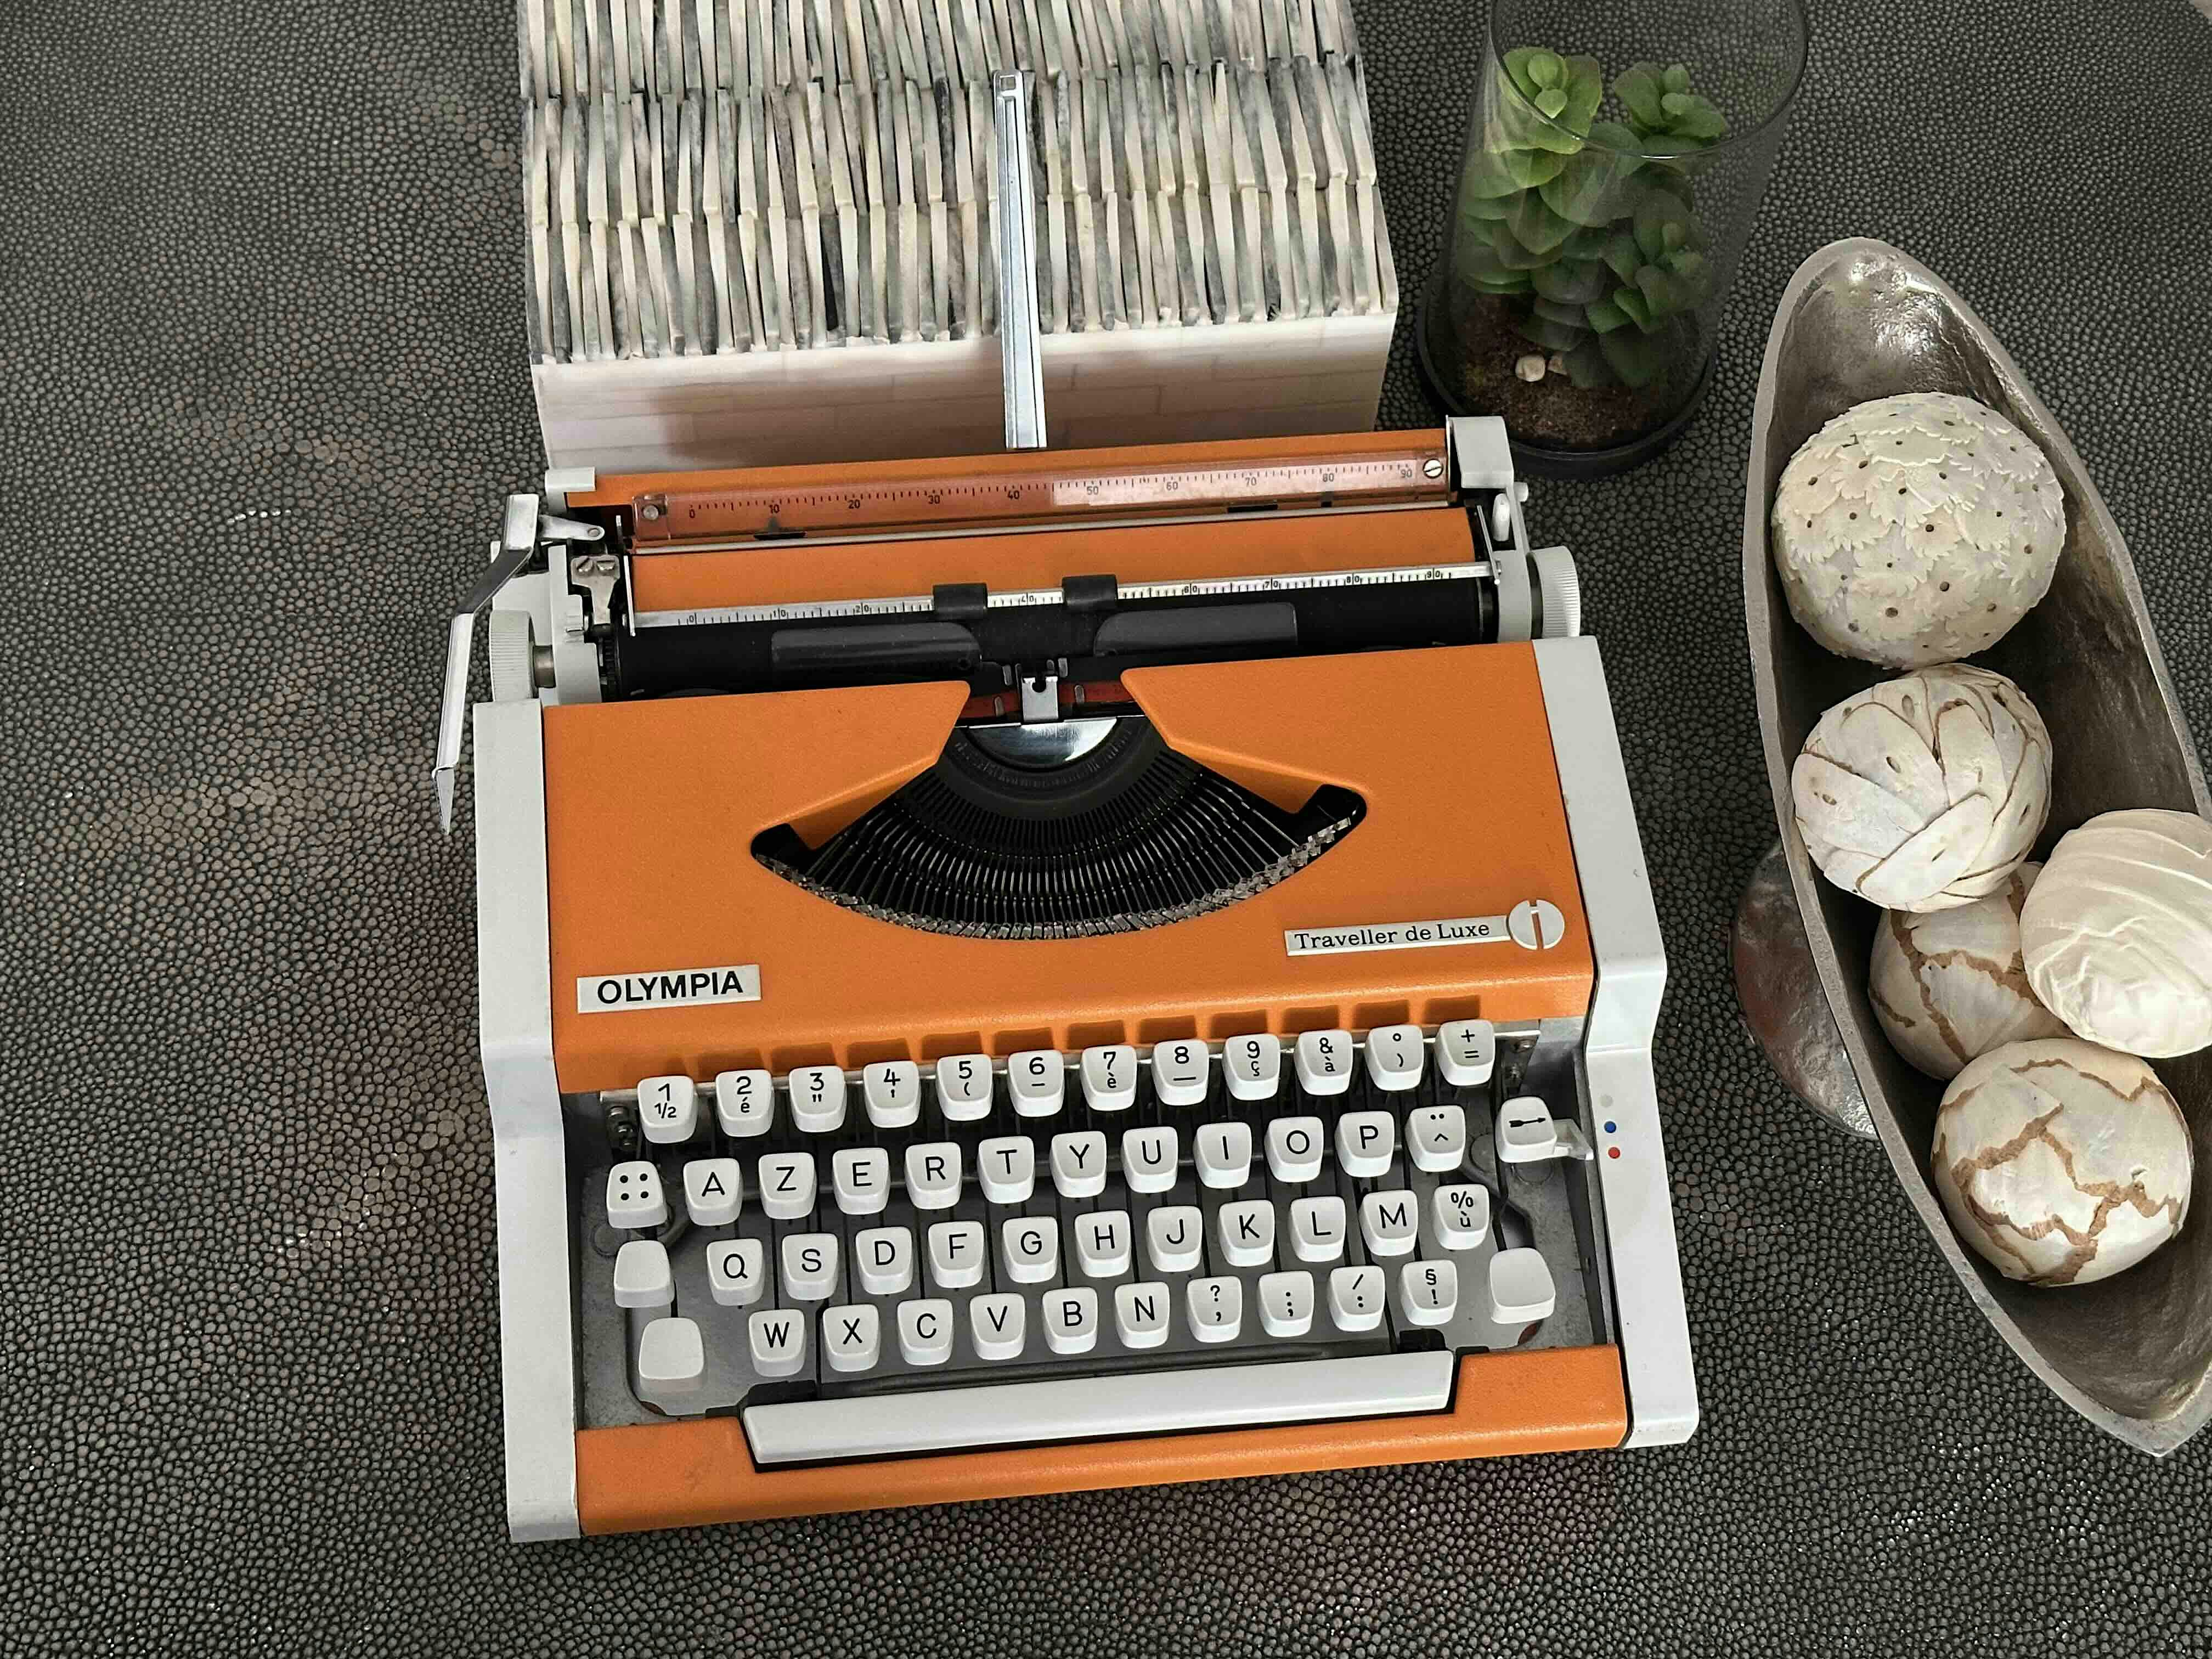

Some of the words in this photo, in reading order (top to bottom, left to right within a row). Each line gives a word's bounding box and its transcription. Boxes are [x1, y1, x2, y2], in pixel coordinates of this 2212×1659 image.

[689, 509, 695, 518] 0
[769, 504, 780, 514] 10
[848, 500, 860, 509] 20
[928, 495, 940, 504] 30
[1007, 490, 1019, 500] 40
[1086, 486, 1098, 495] 50
[1166, 482, 1178, 490] 60
[1245, 477, 1257, 486] 70
[1322, 473, 1334, 482] 80
[1401, 469, 1412, 478] 90
[1265, 580, 1278, 589] 70
[1346, 575, 1359, 584] 80
[1427, 571, 1440, 579] 90
[1295, 928, 1398, 950] Traveller
[1406, 925, 1431, 941] de
[1437, 922, 1490, 939] Luxe
[597, 970, 743, 1004] OLYMPIA
[1175, 1046, 1189, 1064] 8
[1246, 1040, 1260, 1059] 9
[1319, 1037, 1334, 1054] &
[959, 1060, 972, 1079] 5
[1029, 1057, 1045, 1075] 6
[1103, 1051, 1116, 1070] 7
[1250, 1060, 1260, 1076] ç
[1324, 1056, 1335, 1072] à
[736, 1076, 752, 1094] 2
[810, 1073, 824, 1091] 3
[883, 1068, 901, 1086] 4
[1107, 1072, 1117, 1088] è
[658, 1083, 670, 1102] 1
[741, 1097, 751, 1113] é
[1222, 1136, 1229, 1160] I
[1286, 1130, 1310, 1154] O
[1359, 1125, 1378, 1150] P
[996, 1149, 1017, 1175] T
[1069, 1144, 1090, 1169] Y
[1142, 1139, 1162, 1165] U
[776, 1166, 797, 1192] Z
[853, 1161, 872, 1187] E
[925, 1156, 946, 1181] R
[702, 1172, 725, 1197] A
[1451, 1191, 1474, 1209] %
[1239, 1214, 1260, 1240] K
[1312, 1211, 1332, 1236] L
[1379, 1203, 1407, 1229] M
[1459, 1211, 1471, 1228] ù
[1020, 1231, 1042, 1256] G
[1094, 1224, 1115, 1251] H
[1166, 1219, 1185, 1244] J
[874, 1240, 895, 1266] D
[948, 1233, 968, 1259] F
[723, 1254, 748, 1279] Q
[802, 1248, 822, 1272] S
[1352, 1273, 1364, 1290] /
[1425, 1268, 1437, 1285] §
[1210, 1285, 1221, 1302] ?
[1431, 1289, 1438, 1305] !
[987, 1305, 1008, 1332] V
[1063, 1301, 1083, 1327] B
[1135, 1295, 1155, 1322] N
[764, 1322, 789, 1348] W
[843, 1318, 863, 1345] X
[917, 1313, 937, 1339] C
